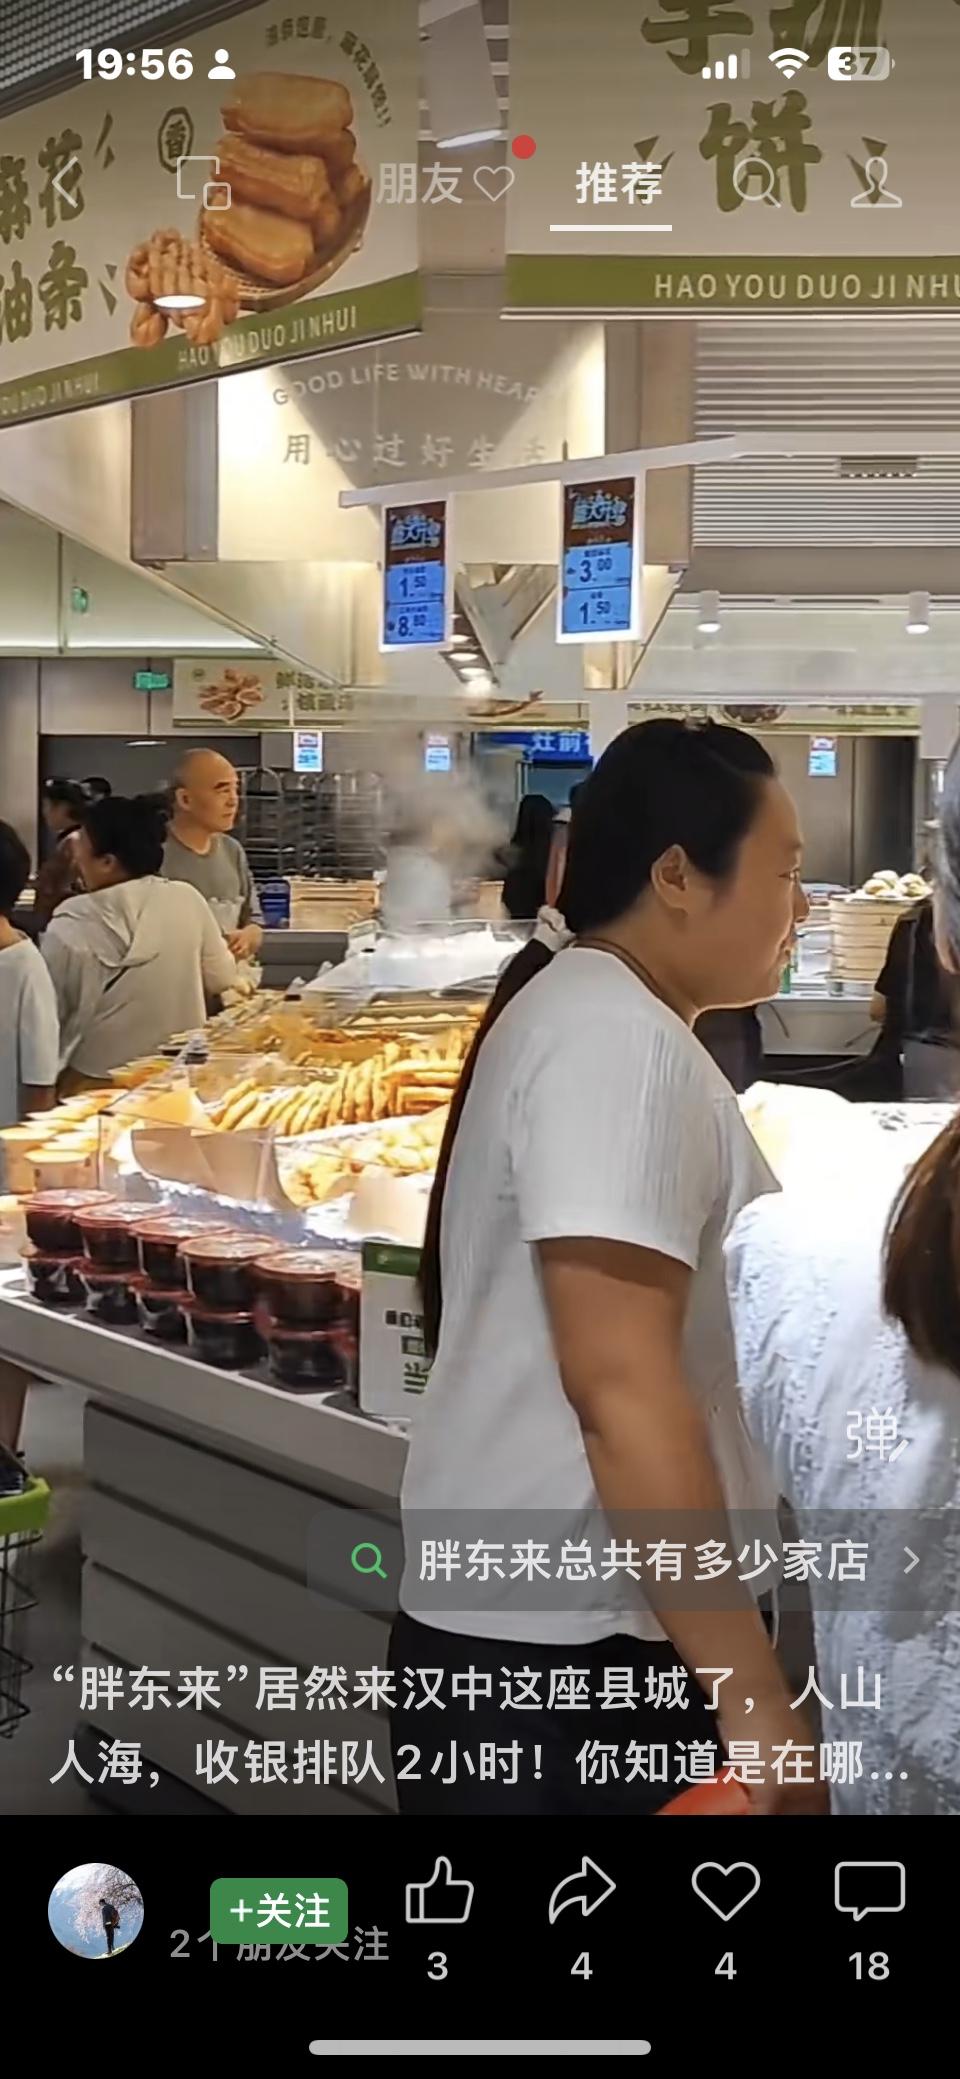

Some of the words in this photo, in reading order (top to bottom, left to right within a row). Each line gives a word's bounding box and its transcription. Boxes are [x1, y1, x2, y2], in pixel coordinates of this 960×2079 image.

[0, 128, 85, 245] 麻花
[699, 89, 823, 213] 饼
[0, 240, 88, 345] 油条
[655, 273, 717, 299] HAO
[725, 273, 786, 299] YOU
[796, 273, 861, 299] DUO
[248, 324, 286, 353] DUO
[272, 370, 344, 406] GOOD
[350, 363, 401, 386] LIFE
[406, 363, 472, 386] WITH
